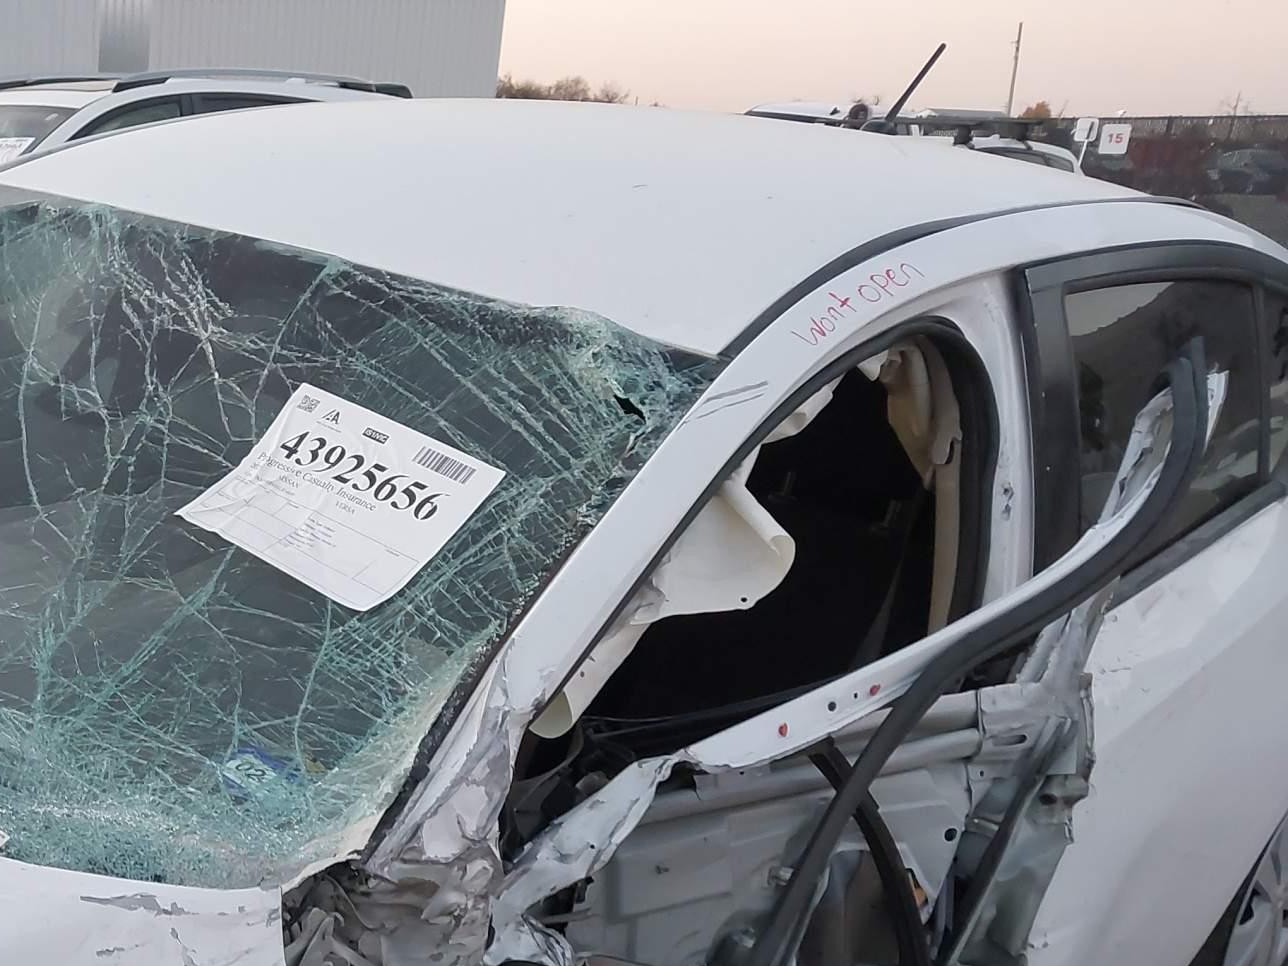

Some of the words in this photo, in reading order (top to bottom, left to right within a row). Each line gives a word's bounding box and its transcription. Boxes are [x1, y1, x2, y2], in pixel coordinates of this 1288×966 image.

[1108, 132, 1124, 144] 15
[280, 431, 451, 520] 43925656
[336, 487, 377, 511] Insurance
